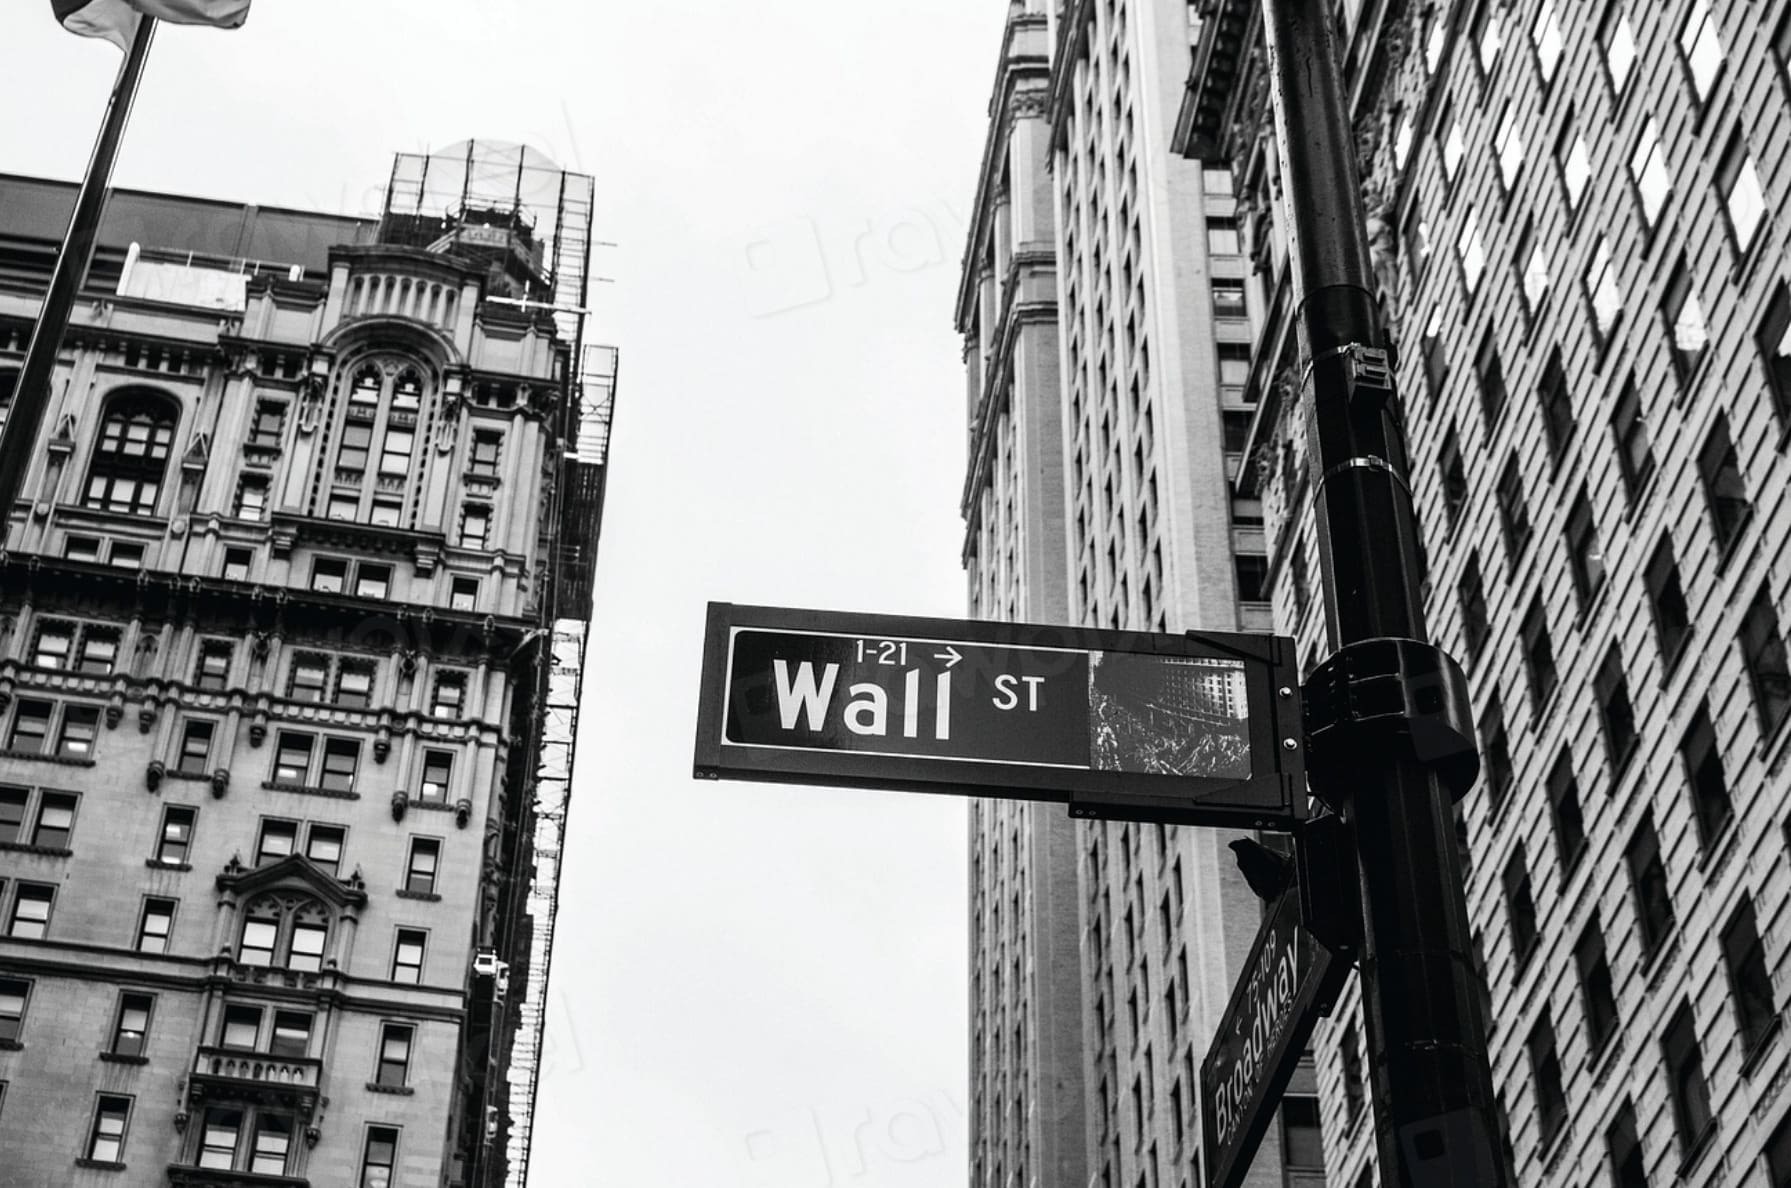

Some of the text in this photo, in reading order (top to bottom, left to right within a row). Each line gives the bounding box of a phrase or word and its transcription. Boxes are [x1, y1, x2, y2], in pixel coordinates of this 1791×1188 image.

[856, 639, 907, 666] 1-21
[773, 659, 1046, 741] Wall ST
[1214, 924, 1299, 1147] Broadway
